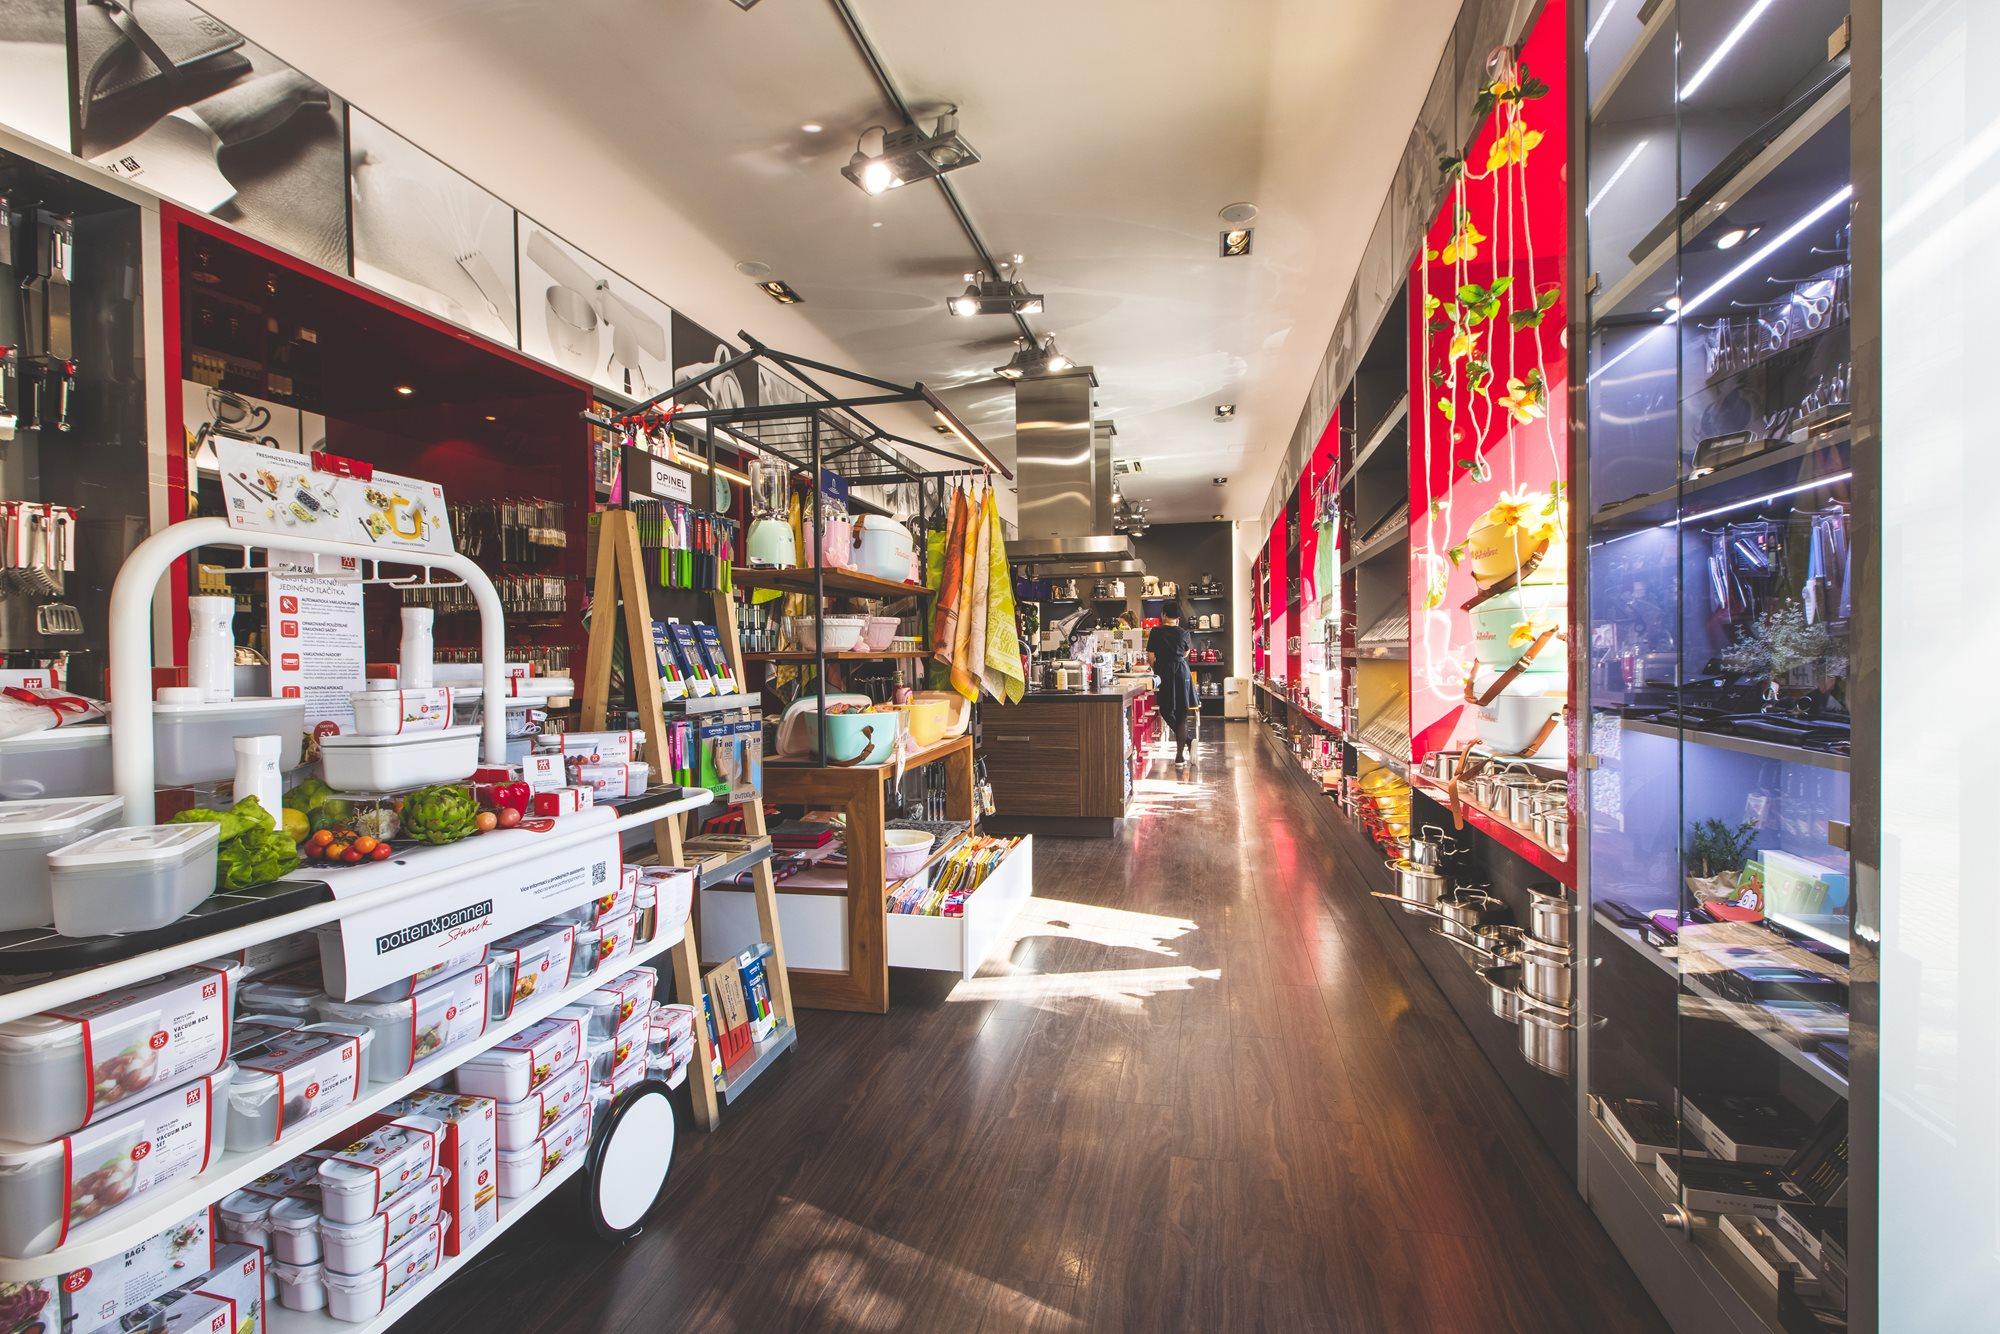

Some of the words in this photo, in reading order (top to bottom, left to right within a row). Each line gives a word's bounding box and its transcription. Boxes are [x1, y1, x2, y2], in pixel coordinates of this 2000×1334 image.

[311, 451, 373, 483] NEW
[656, 471, 687, 490] OPINEL
[279, 582, 315, 593] JEDINÉHO
[316, 586, 346, 596] TLAČÍTKA
[379, 900, 493, 954] potten&pannen
[173, 1020, 197, 1033] VACUUM
[197, 1015, 209, 1024] BOX
[153, 1036, 165, 1046] 5X
[173, 1031, 183, 1039] SET
[156, 1127, 180, 1142] VACUUM
[181, 1121, 193, 1131] BOX
[156, 1141, 166, 1149] SET
[135, 1147, 147, 1158] 5X
[124, 1244, 146, 1260] BAGS
[124, 1259, 133, 1268] M
[69, 1269, 86, 1280] FRESH
[70, 1275, 86, 1289] 5X
